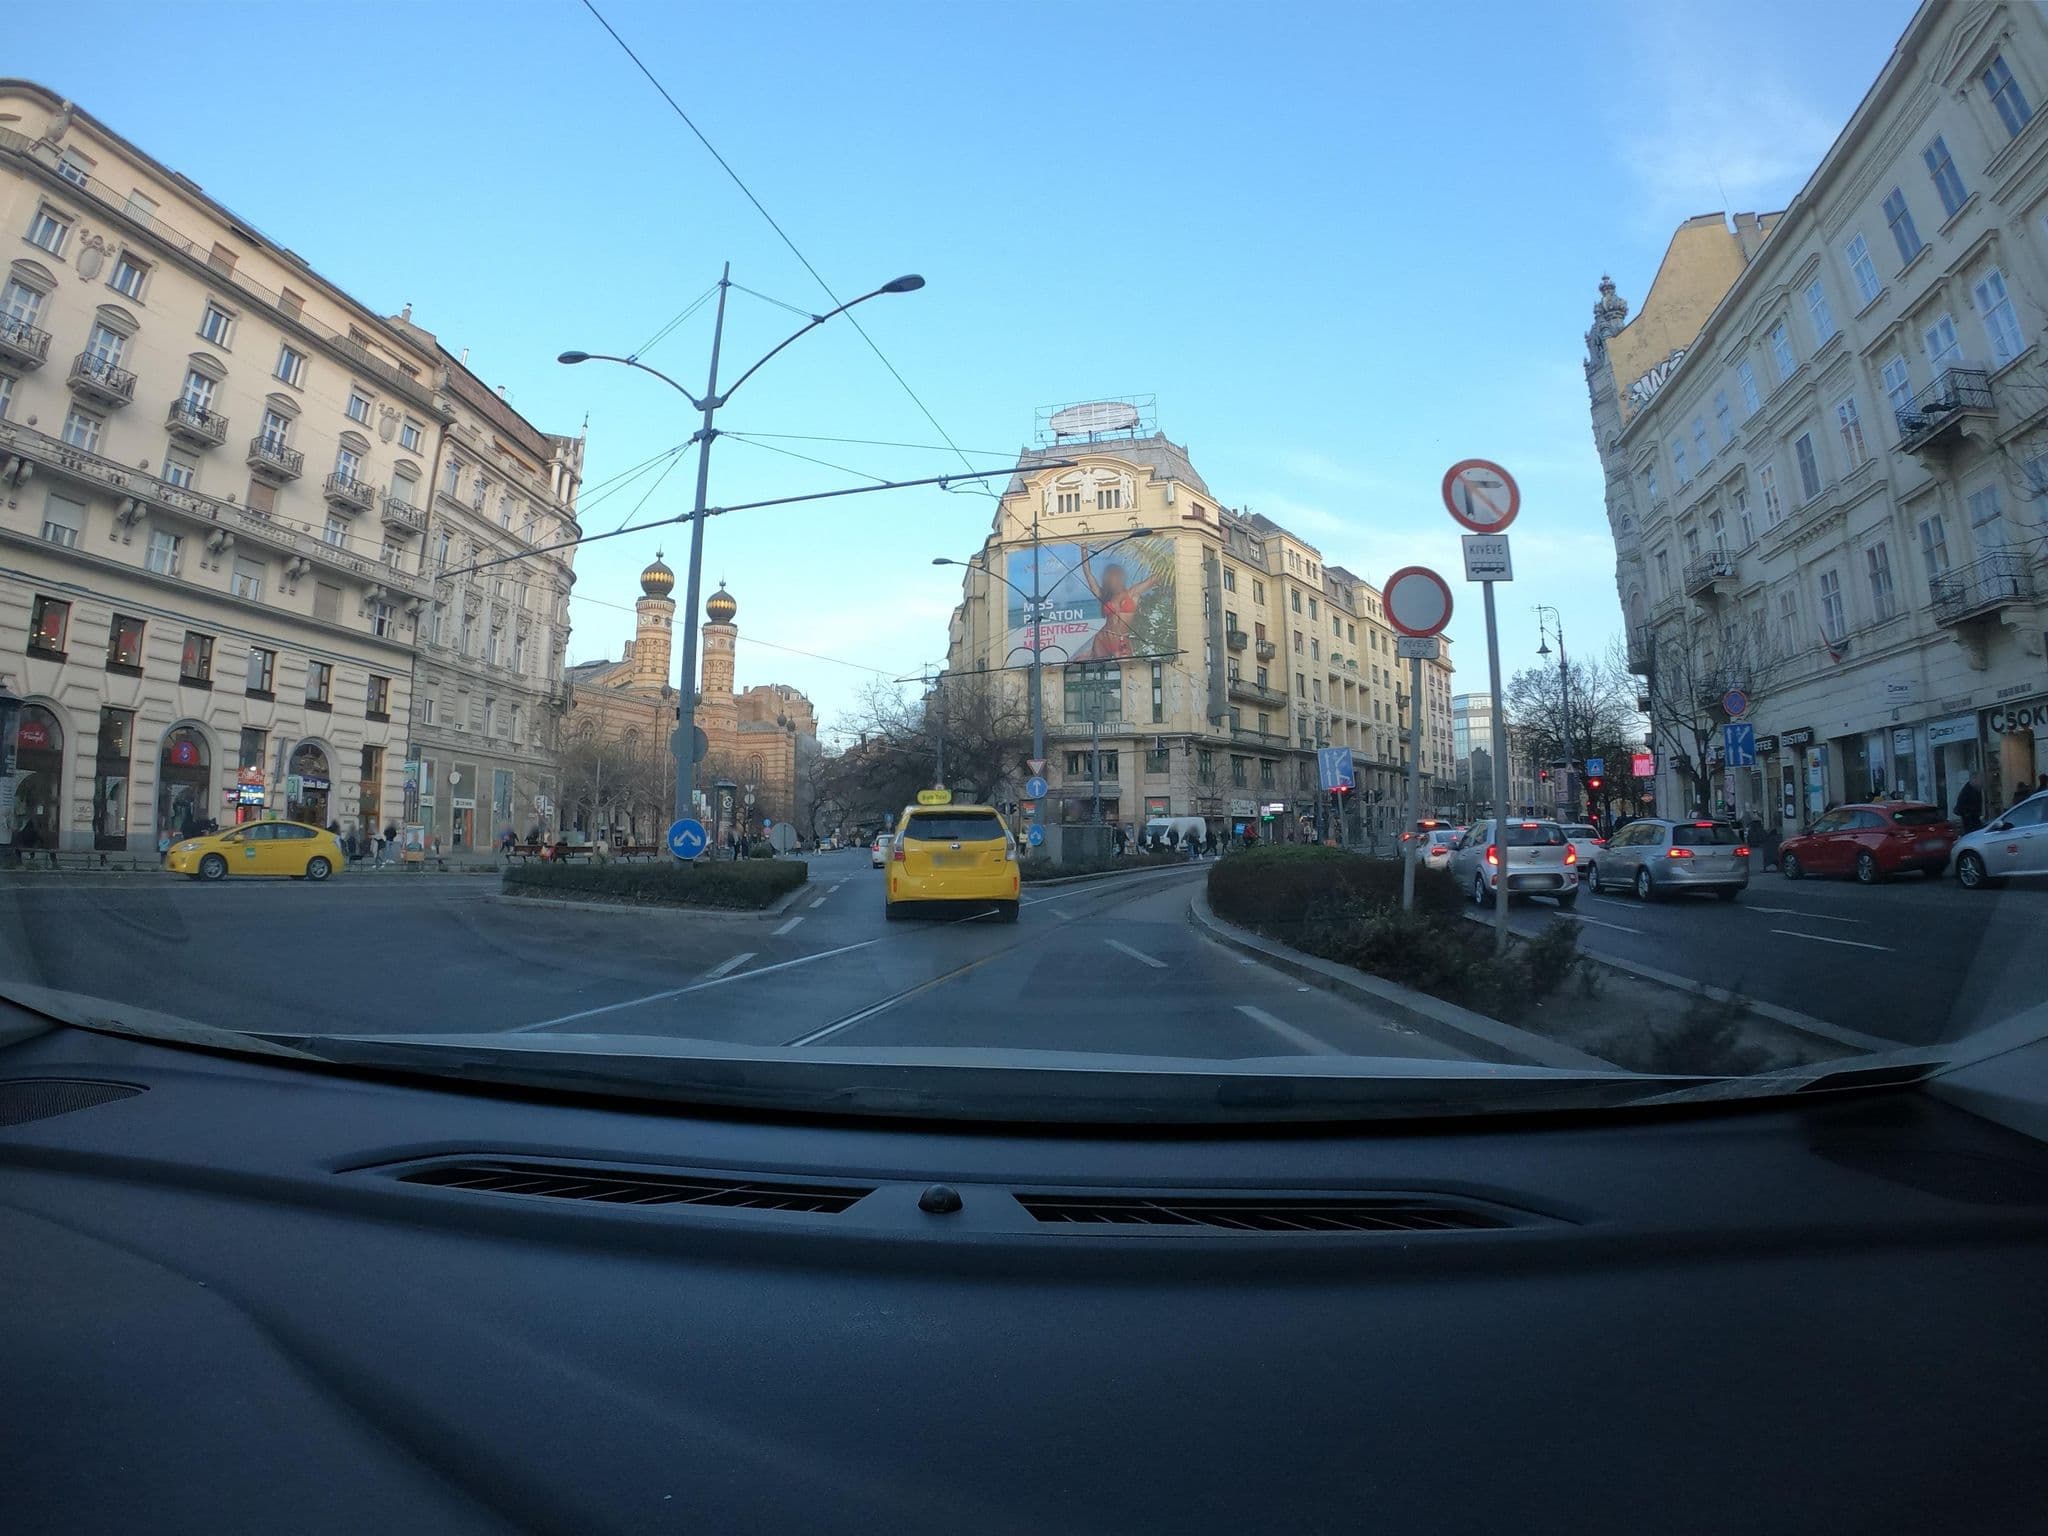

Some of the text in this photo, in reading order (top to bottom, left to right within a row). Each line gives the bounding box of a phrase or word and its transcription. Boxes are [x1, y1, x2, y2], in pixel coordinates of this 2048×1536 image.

[1023, 599, 1054, 613] MSS
[1023, 608, 1084, 625] BLATON
[1024, 622, 1089, 639] JEENTKEZZ
[1023, 635, 1056, 650] MST!
[1781, 731, 1809, 747] BISTRO
